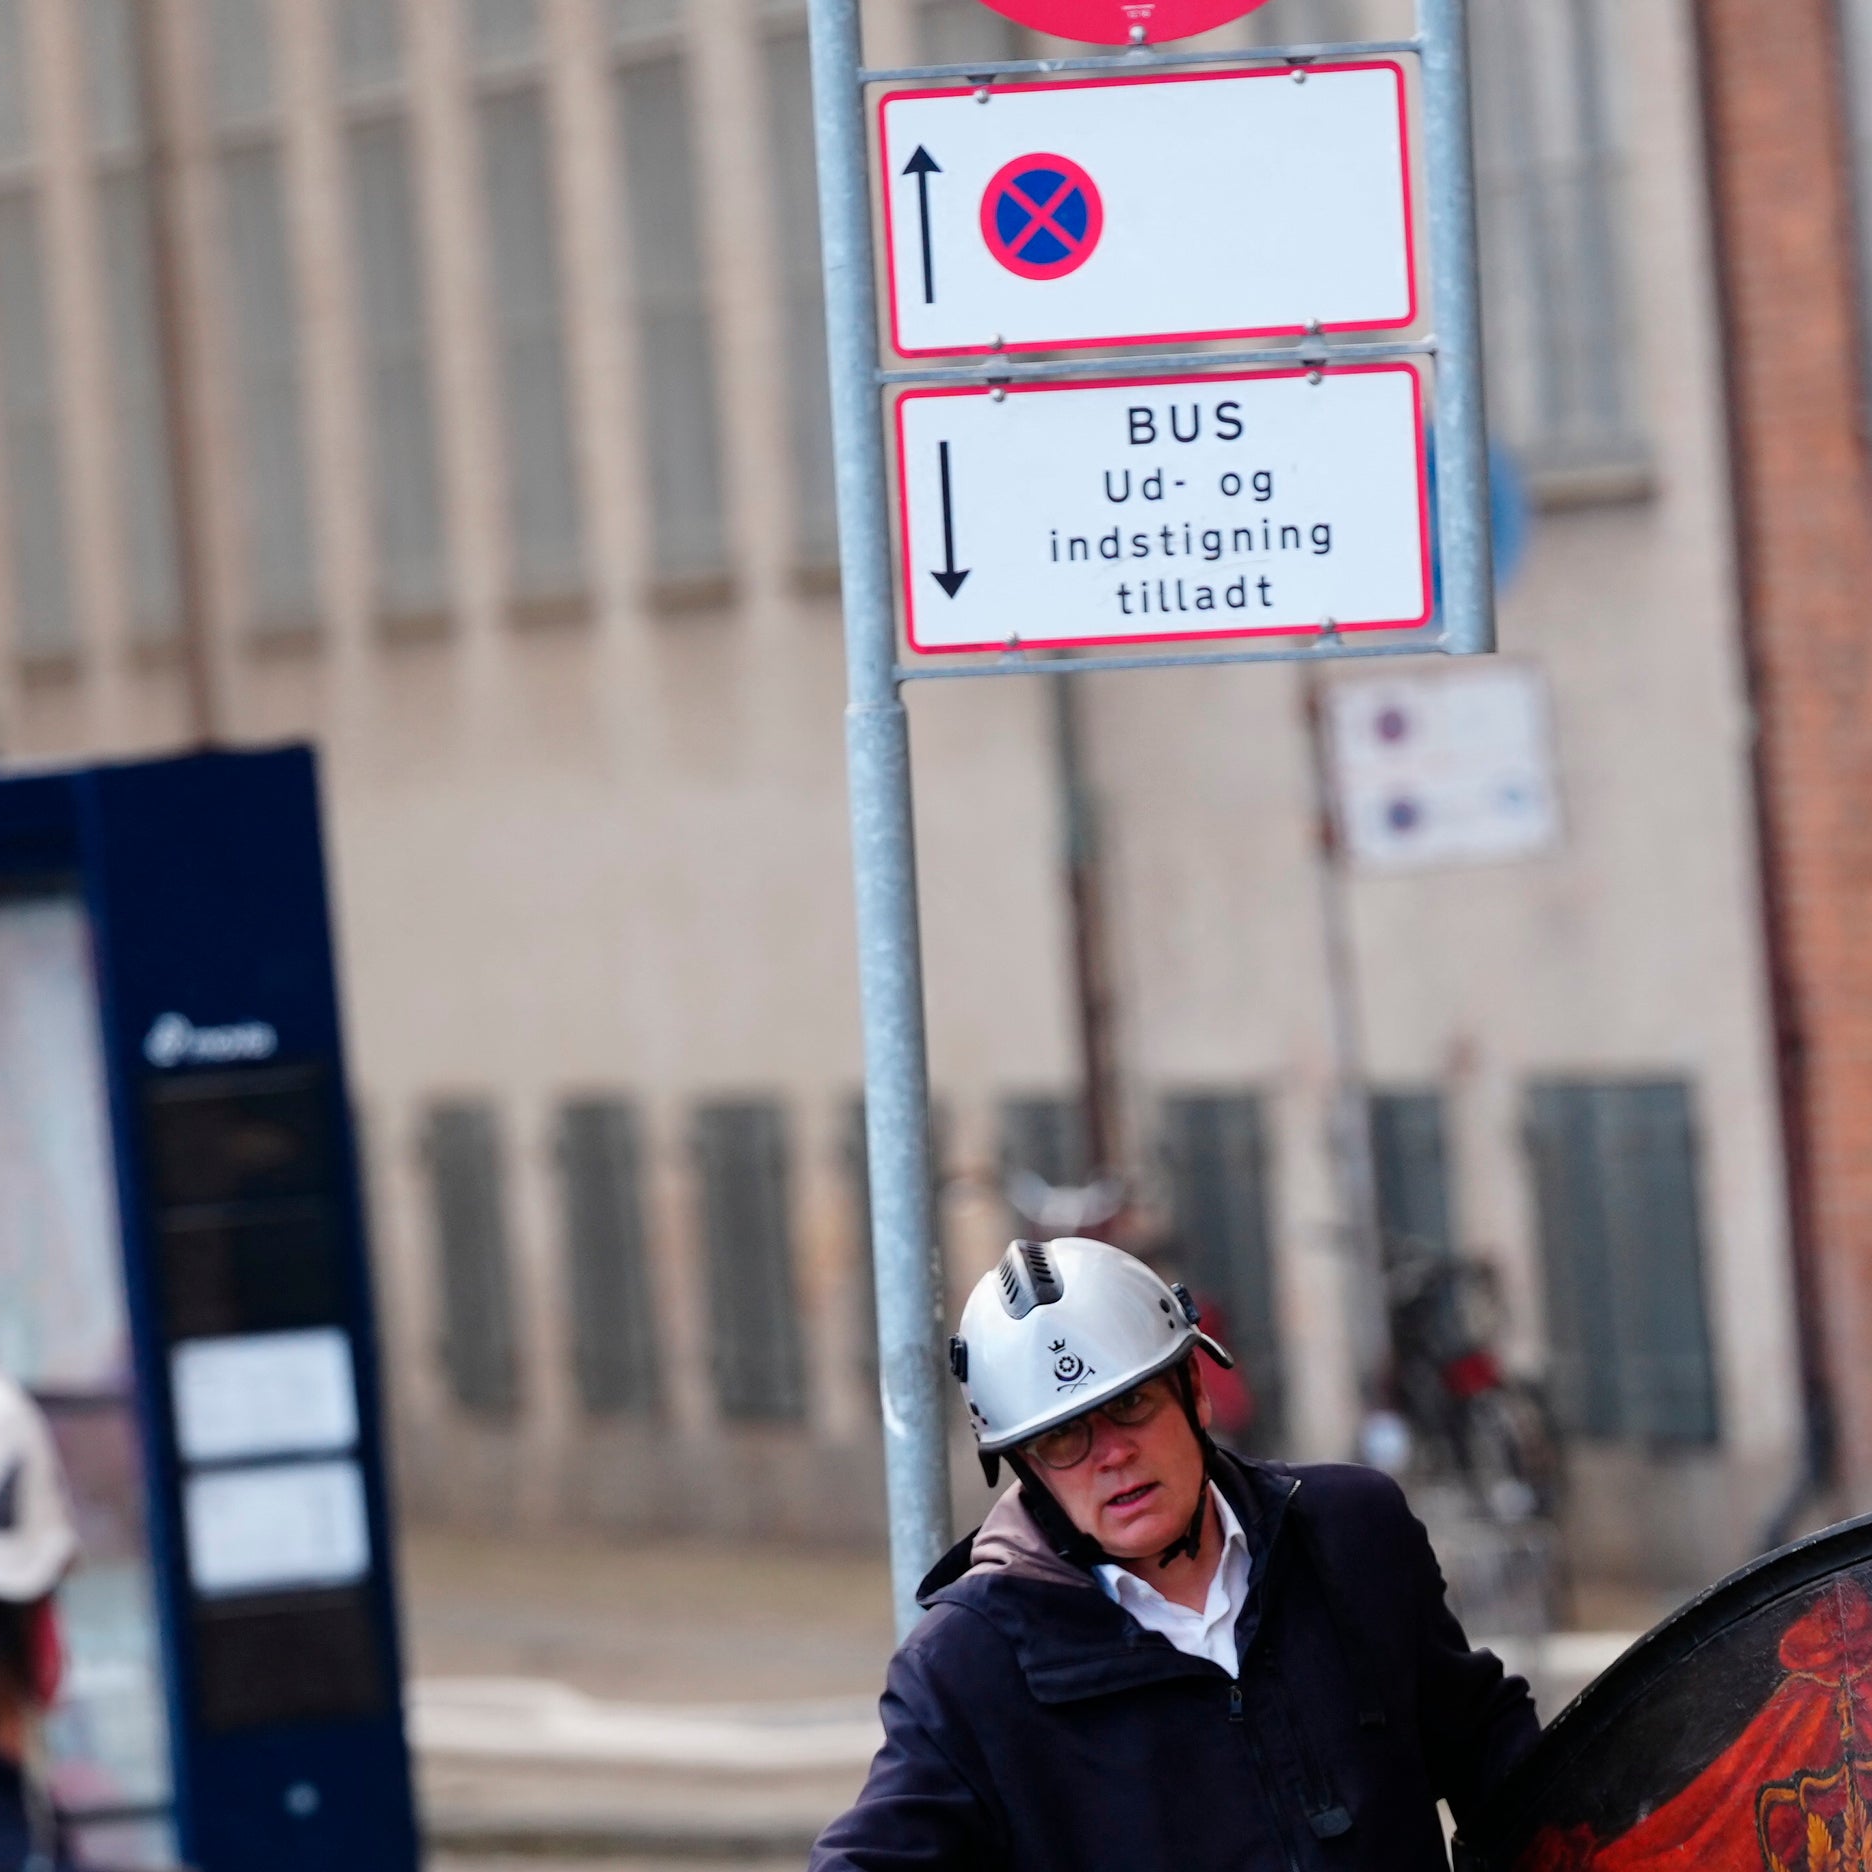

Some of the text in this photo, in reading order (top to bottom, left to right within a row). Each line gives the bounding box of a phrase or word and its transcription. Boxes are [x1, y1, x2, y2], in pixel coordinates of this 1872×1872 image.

[1127, 400, 1245, 445] BUS
[1104, 466, 1274, 503] Ud- og
[1050, 517, 1333, 562] indstigning
[1115, 574, 1274, 615] tilladt
